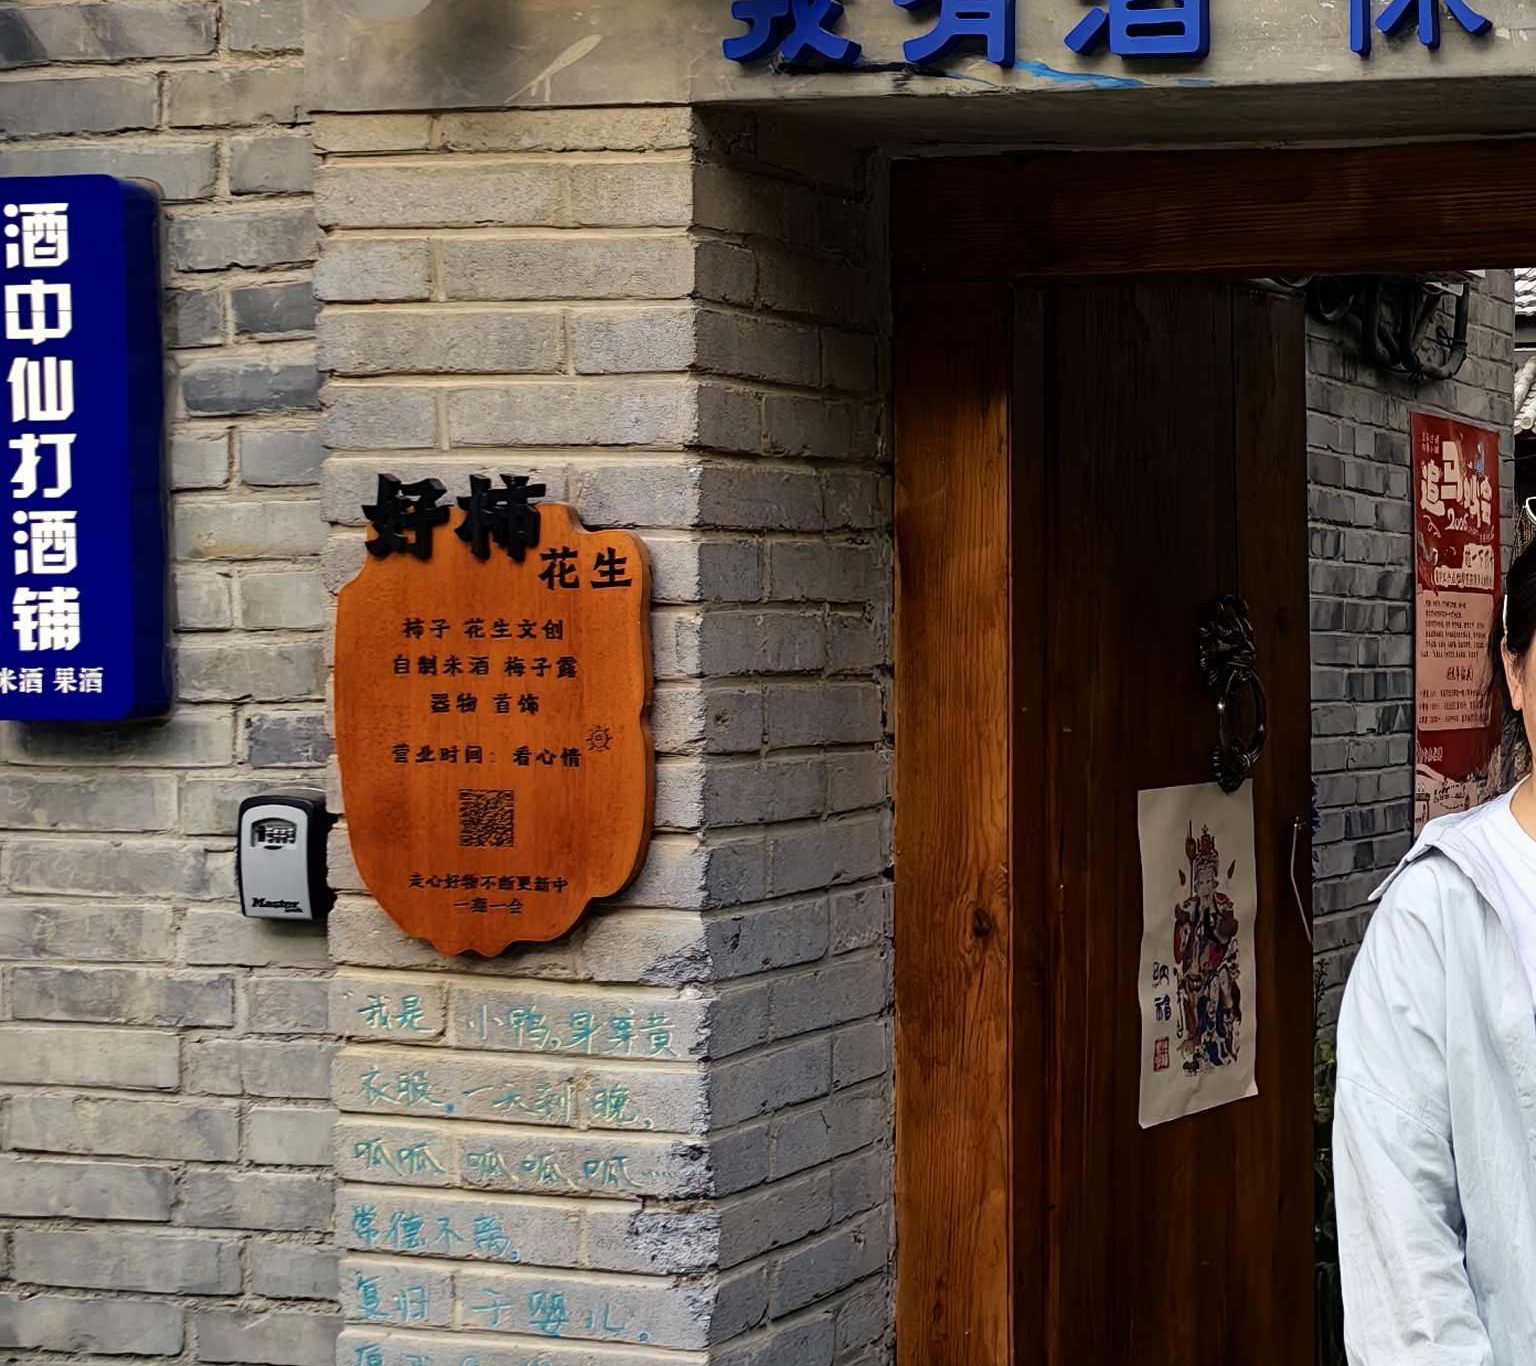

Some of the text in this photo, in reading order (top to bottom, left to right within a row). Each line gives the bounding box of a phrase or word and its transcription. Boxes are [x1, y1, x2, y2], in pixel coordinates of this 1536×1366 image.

[3, 201, 81, 653] 酒中仙打酒铺
[361, 473, 546, 563] 好柿
[539, 546, 632, 590] 花生
[403, 617, 564, 640] 柿子 花生文创
[393, 654, 578, 678] 自制米酒 梅子露
[0, 667, 104, 694] 米酒 果酒
[431, 693, 540, 715] 器物 首饰
